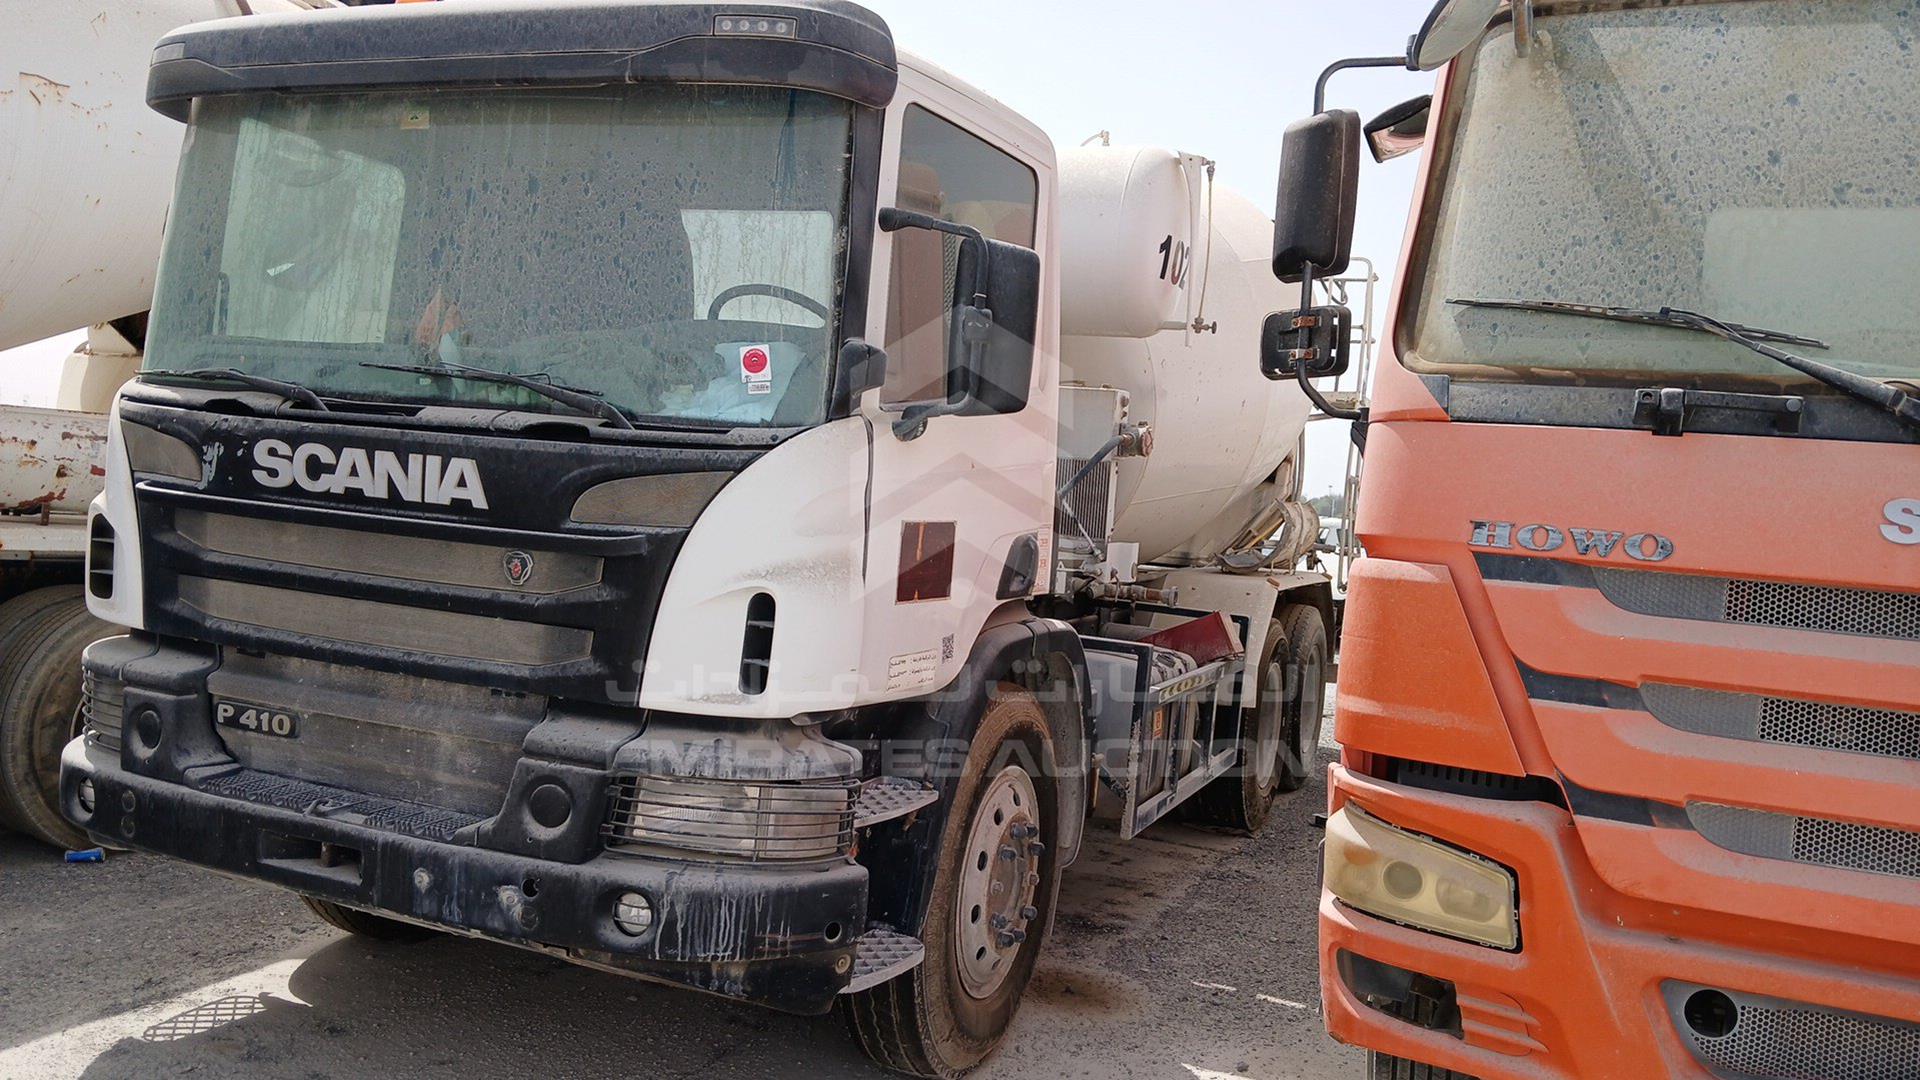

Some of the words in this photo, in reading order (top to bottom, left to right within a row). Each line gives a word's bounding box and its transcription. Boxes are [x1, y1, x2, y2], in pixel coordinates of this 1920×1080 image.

[251, 438, 489, 510] SCANIA
[1469, 519, 1674, 562] HOWO
[217, 703, 235, 723] P
[239, 709, 291, 735] 410
